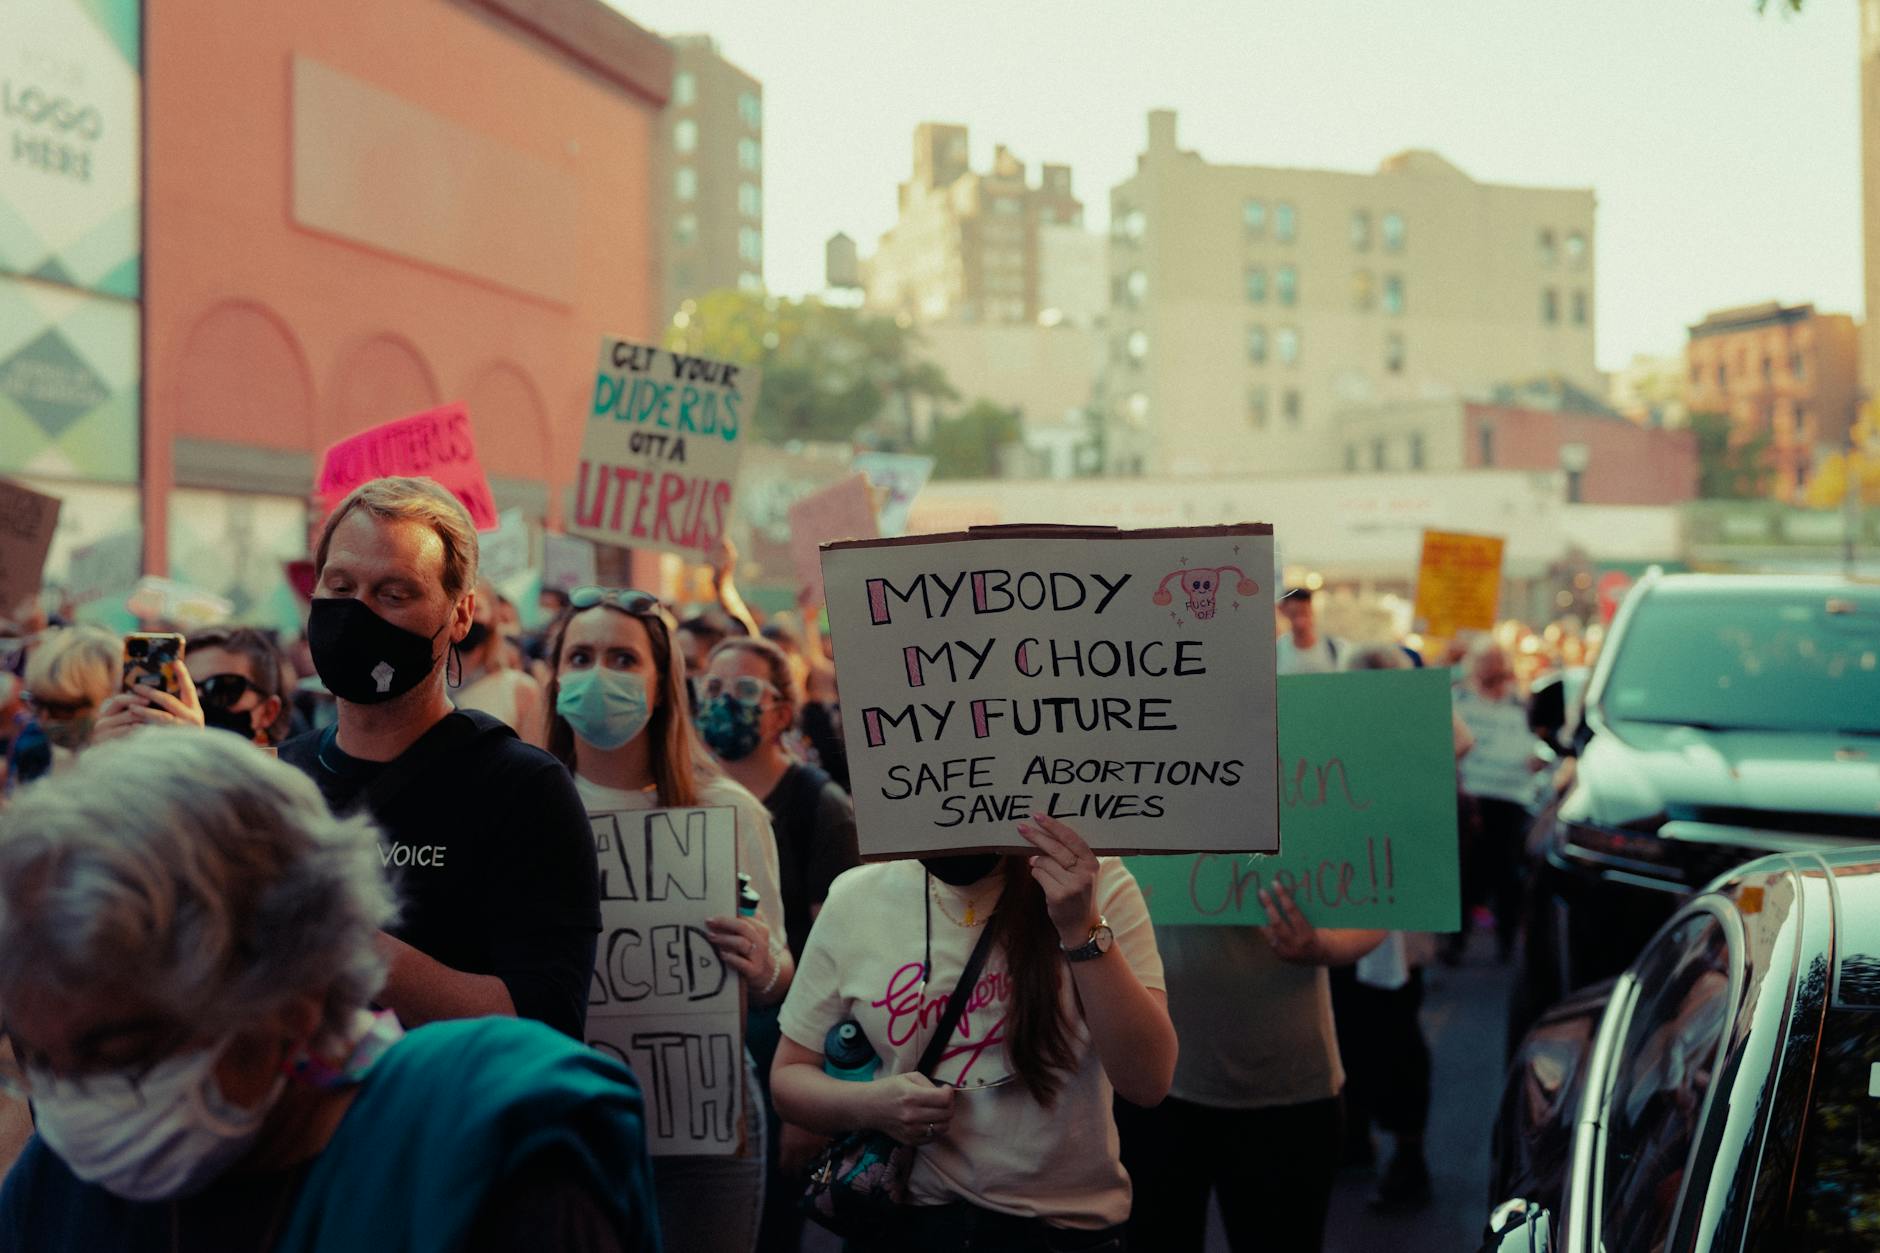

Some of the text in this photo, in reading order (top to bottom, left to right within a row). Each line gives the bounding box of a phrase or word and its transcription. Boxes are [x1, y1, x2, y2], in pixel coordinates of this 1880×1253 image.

[3, 78, 102, 141] LOGO
[612, 342, 739, 388] GET YOUR
[574, 461, 732, 552] UTERUS
[865, 569, 1133, 625] MY BODY
[902, 637, 1207, 687] MY CHOICE
[861, 697, 1178, 748] MY FUTURE
[881, 755, 1244, 800] SAFE ABORTIONS
[1280, 755, 1373, 812] en
[933, 792, 1165, 827] SAVE LIVES
[376, 841, 447, 869] VOICE
[1189, 832, 1396, 916] Choice!!
[589, 925, 728, 1002] CED
[588, 1032, 735, 1143] TH
